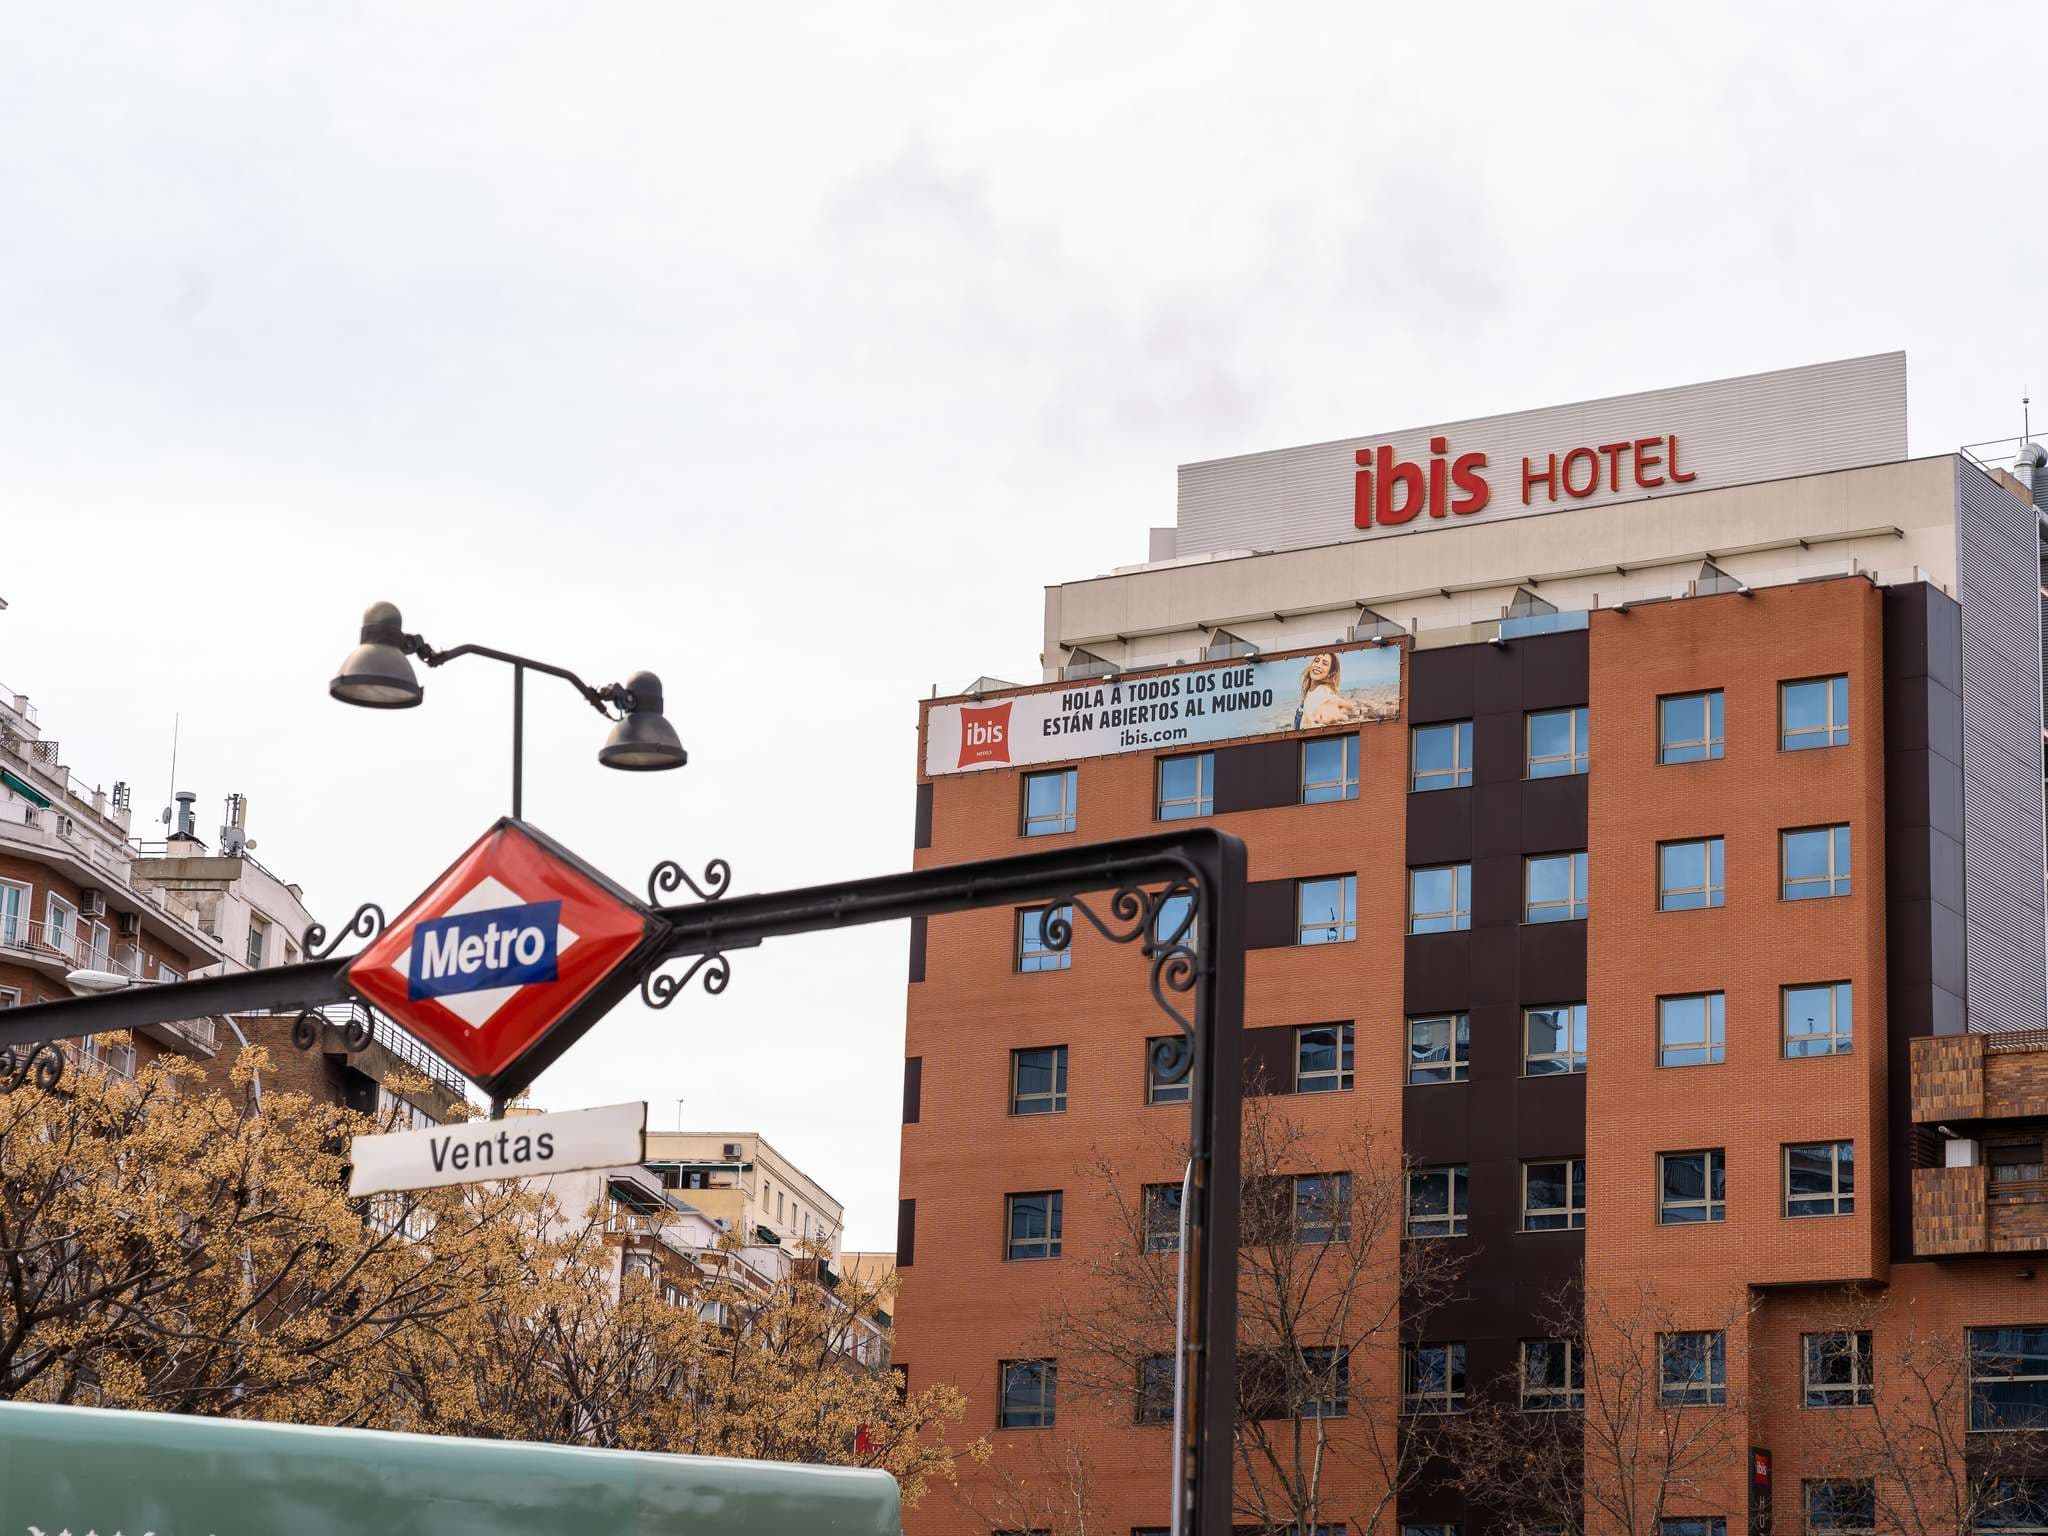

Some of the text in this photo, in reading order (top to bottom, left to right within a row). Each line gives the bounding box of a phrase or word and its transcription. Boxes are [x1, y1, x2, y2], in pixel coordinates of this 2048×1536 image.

[1354, 434, 1696, 529] ibis HOTEL
[1062, 668, 1254, 712] HOLA A TODOS LOS QUE
[967, 720, 1003, 746] ibis
[1043, 688, 1273, 737] ESTÁN ABIERTOS AL MUNDO
[1119, 727, 1188, 747] ibis.com
[421, 922, 546, 980] Metro
[430, 1131, 555, 1173] Ventas
